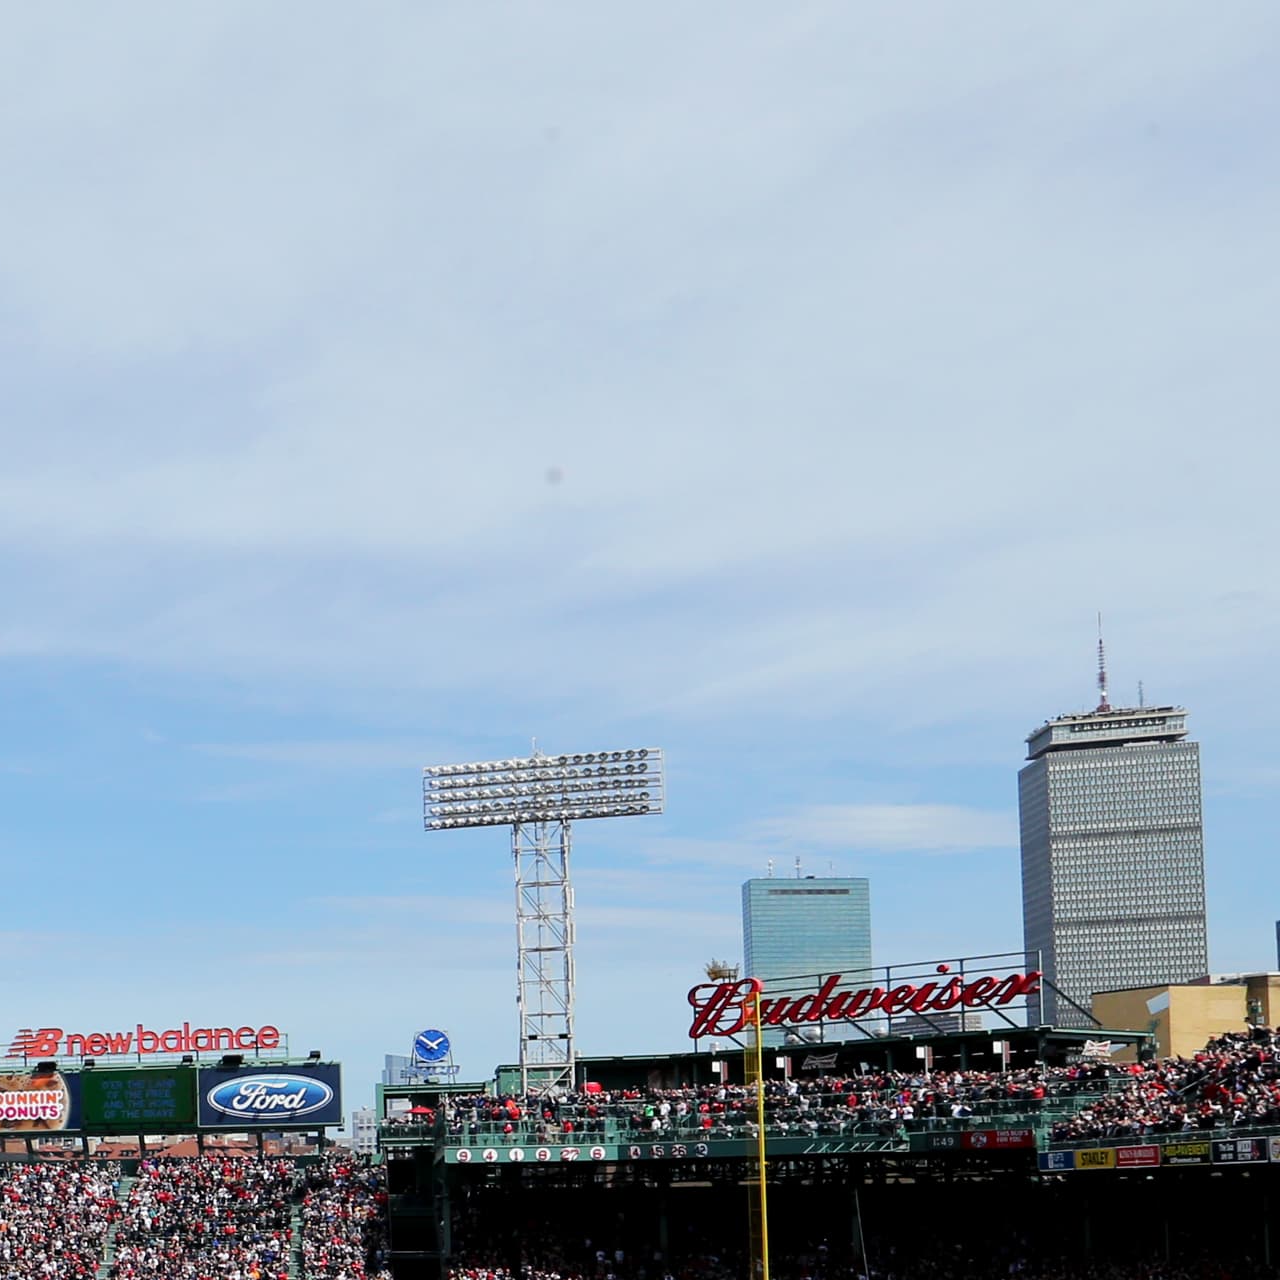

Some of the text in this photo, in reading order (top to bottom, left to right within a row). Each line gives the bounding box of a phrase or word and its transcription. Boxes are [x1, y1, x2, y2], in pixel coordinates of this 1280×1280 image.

[688, 964, 1041, 1038] Budweiser
[67, 1022, 279, 1056] new balance
[232, 1081, 308, 1110] Ford
